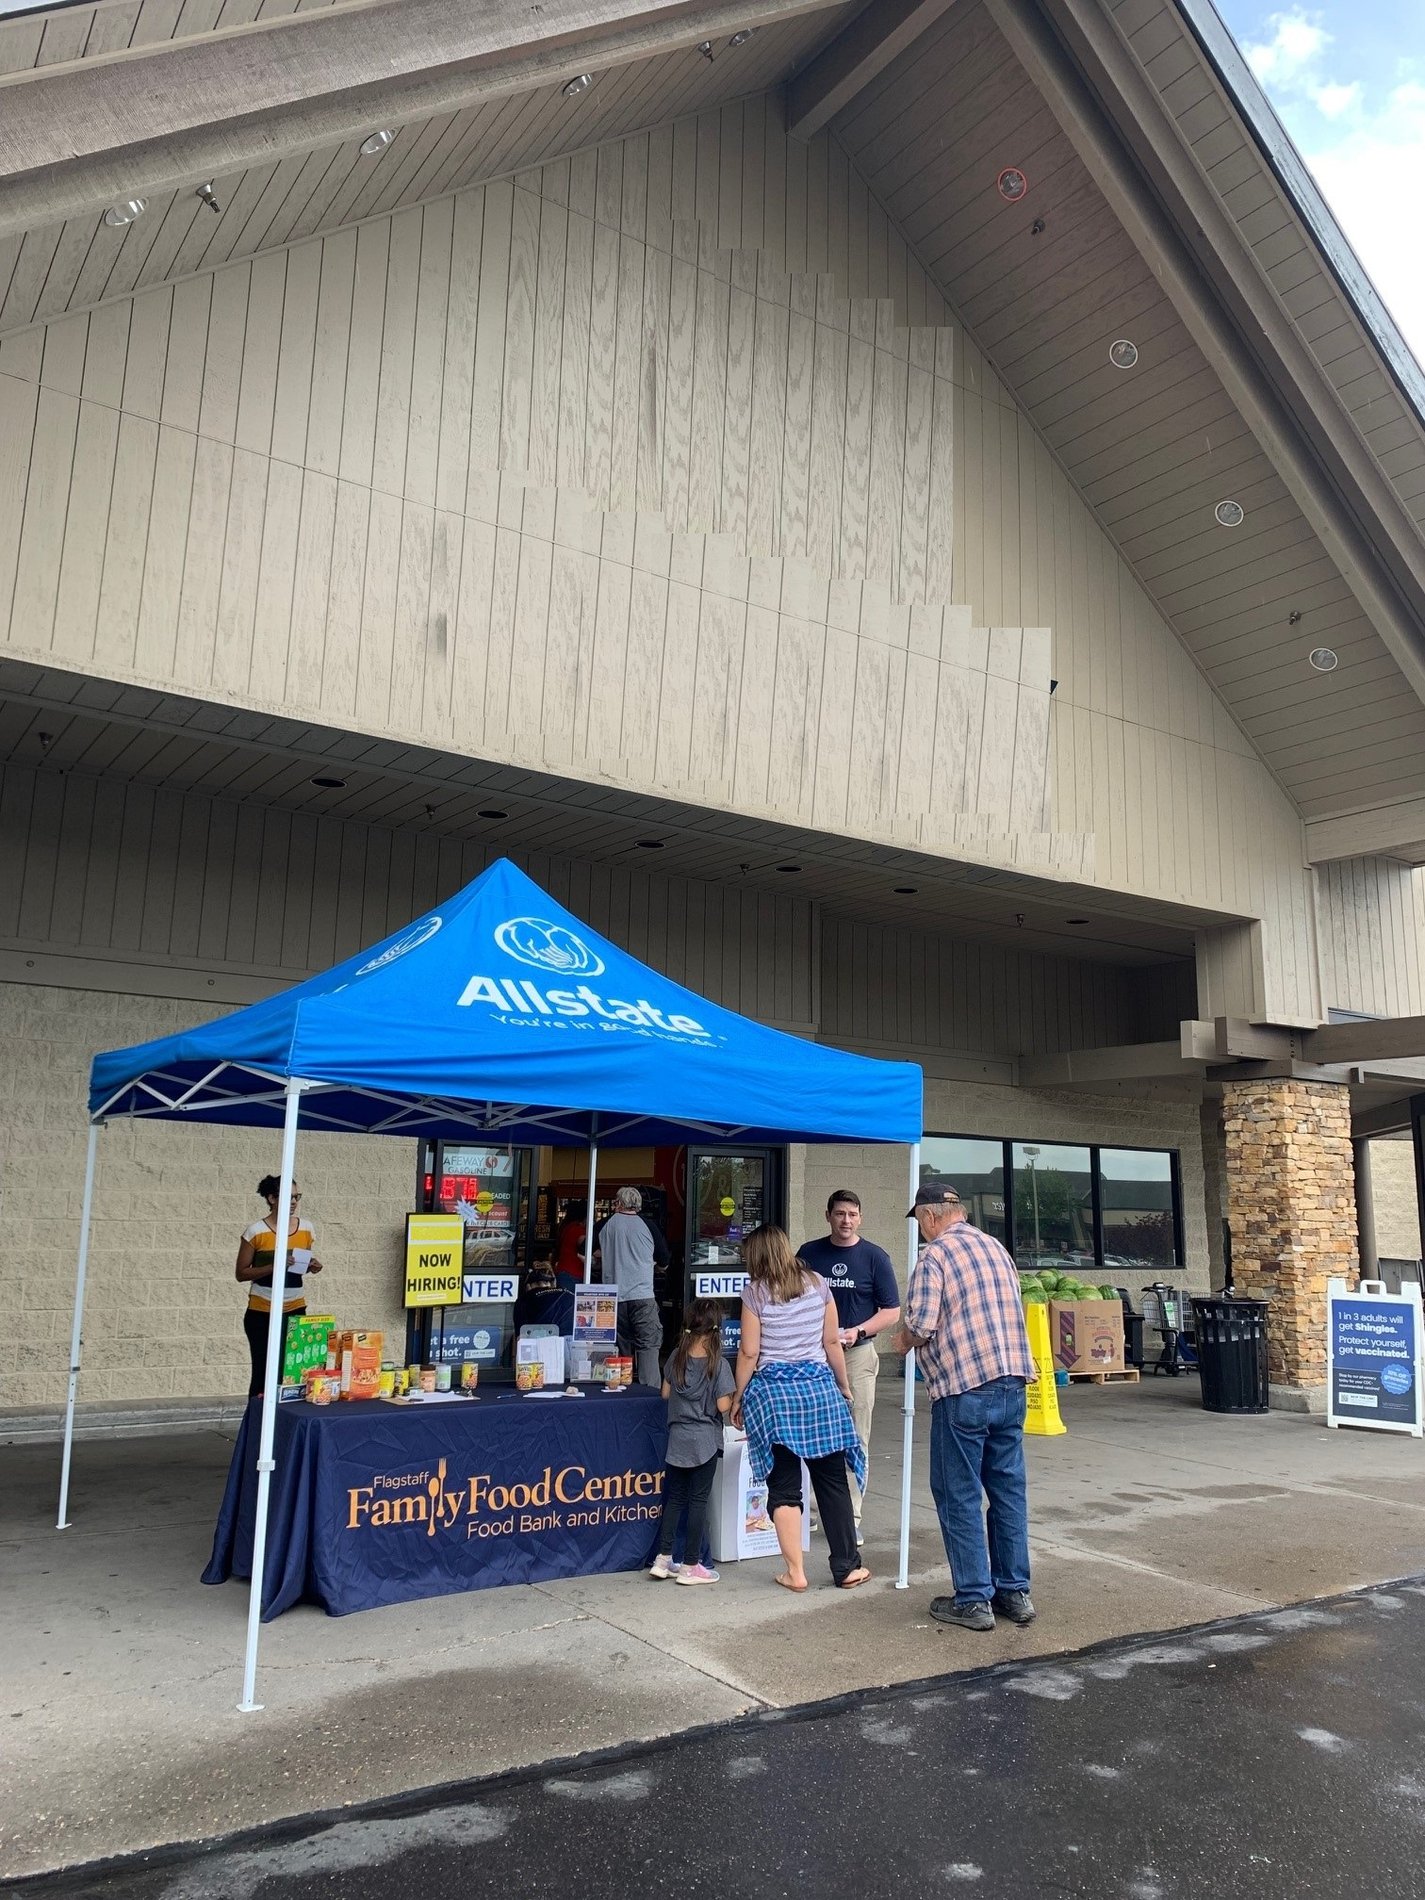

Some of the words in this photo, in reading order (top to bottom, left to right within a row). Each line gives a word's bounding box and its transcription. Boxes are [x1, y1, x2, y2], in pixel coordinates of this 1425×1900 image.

[456, 976, 711, 1037] Allstate
[489, 1013, 568, 1029] You're
[571, 1020, 595, 1030] in
[443, 1155, 485, 1166] AFEWAY
[448, 1166, 487, 1175] GASOLINE
[419, 1253, 452, 1268] NOW
[407, 1276, 460, 1292] HIRING!
[463, 1280, 513, 1298] NTER
[823, 1277, 857, 1288] llstate.
[1343, 1311, 1352, 1320] in
[1353, 1312, 1359, 1321] 3
[1361, 1313, 1388, 1323] adults
[1389, 1315, 1404, 1324] will
[1338, 1322, 1354, 1332] get
[1355, 1323, 1398, 1335] Shingles.
[450, 1335, 470, 1345] free
[1338, 1335, 1369, 1346] Protect
[1370, 1339, 1407, 1349] yourself,
[1338, 1346, 1354, 1356] get
[1355, 1347, 1410, 1359] vaccinated.
[373, 1471, 430, 1490] Flagstaff
[467, 1466, 551, 1515] Food
[554, 1466, 666, 1504] Center
[467, 1518, 514, 1540] Food
[519, 1512, 562, 1533] Bank
[567, 1506, 600, 1527] and
